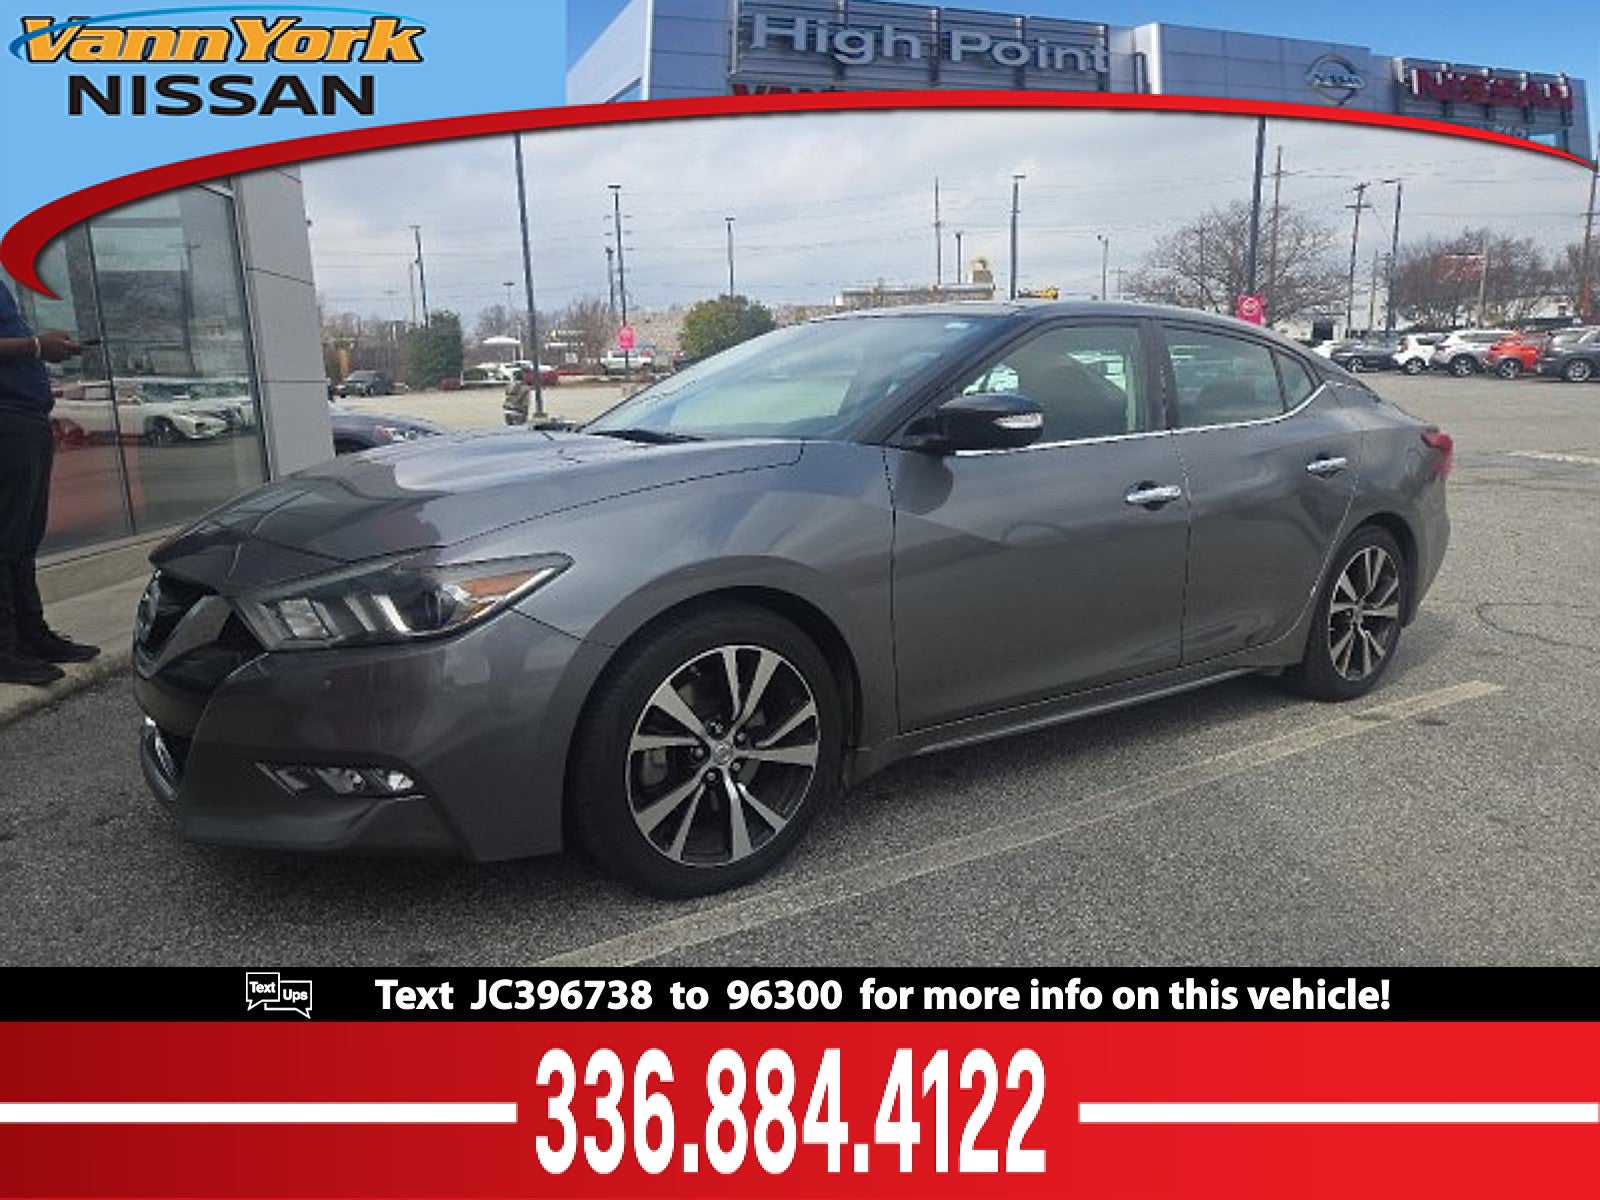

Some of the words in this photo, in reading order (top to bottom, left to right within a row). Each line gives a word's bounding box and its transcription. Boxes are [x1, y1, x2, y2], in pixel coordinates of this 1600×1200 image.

[752, 14, 922, 65] High
[950, 28, 1109, 73] Point
[1411, 69, 1573, 110] NISSAN
